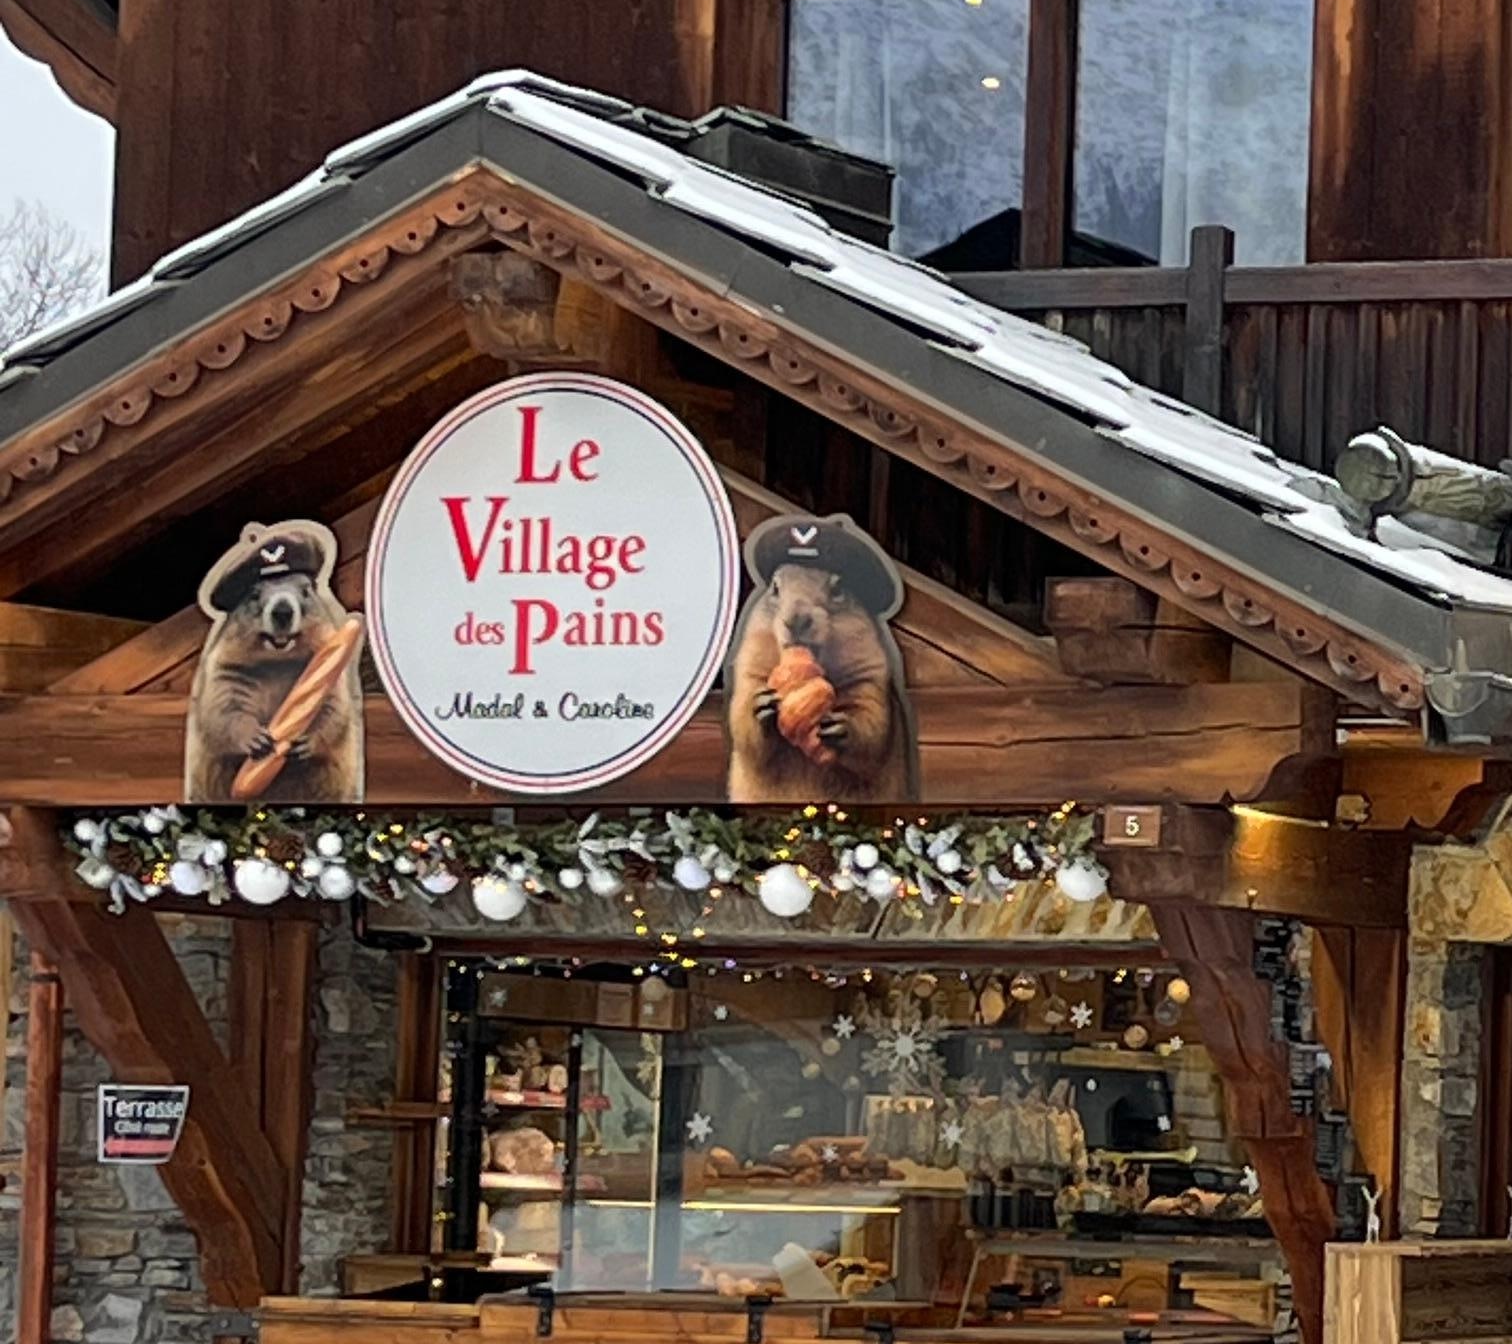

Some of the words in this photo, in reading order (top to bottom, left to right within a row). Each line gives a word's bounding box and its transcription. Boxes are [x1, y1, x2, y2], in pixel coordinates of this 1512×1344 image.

[514, 406, 600, 483] Le
[440, 497, 646, 590] Village
[454, 612, 505, 646] des
[508, 597, 665, 675] Pains
[1126, 815, 1139, 836] 5
[104, 1096, 184, 1118] Terrasse
